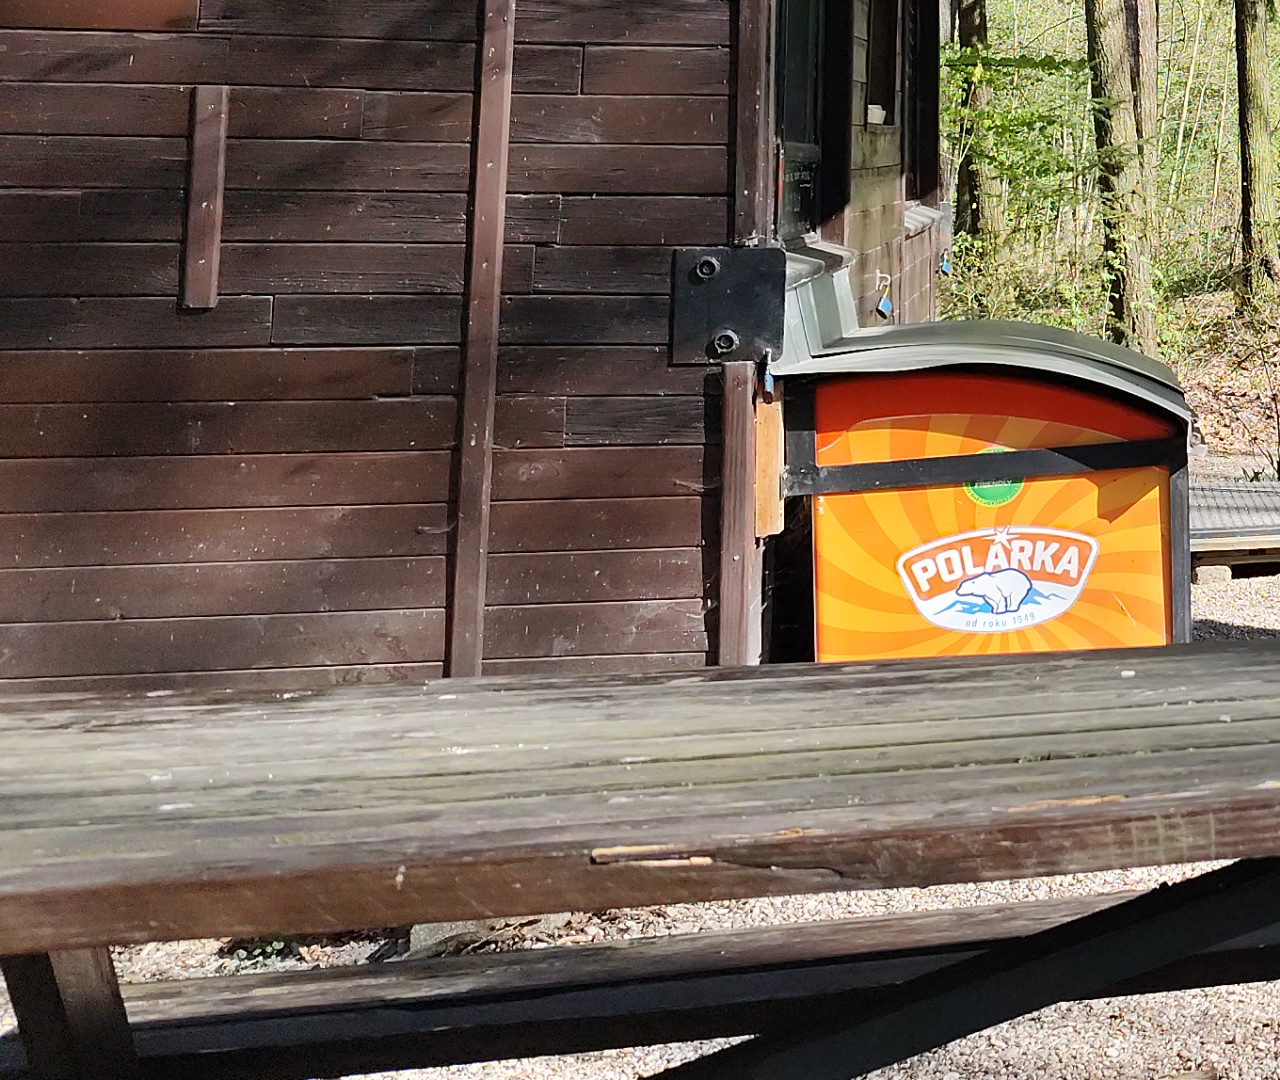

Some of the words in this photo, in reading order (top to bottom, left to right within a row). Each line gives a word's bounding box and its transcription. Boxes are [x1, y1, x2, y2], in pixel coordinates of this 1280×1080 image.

[965, 619, 978, 628] od
[982, 619, 1007, 628] roku
[1012, 611, 1036, 625] 1949
